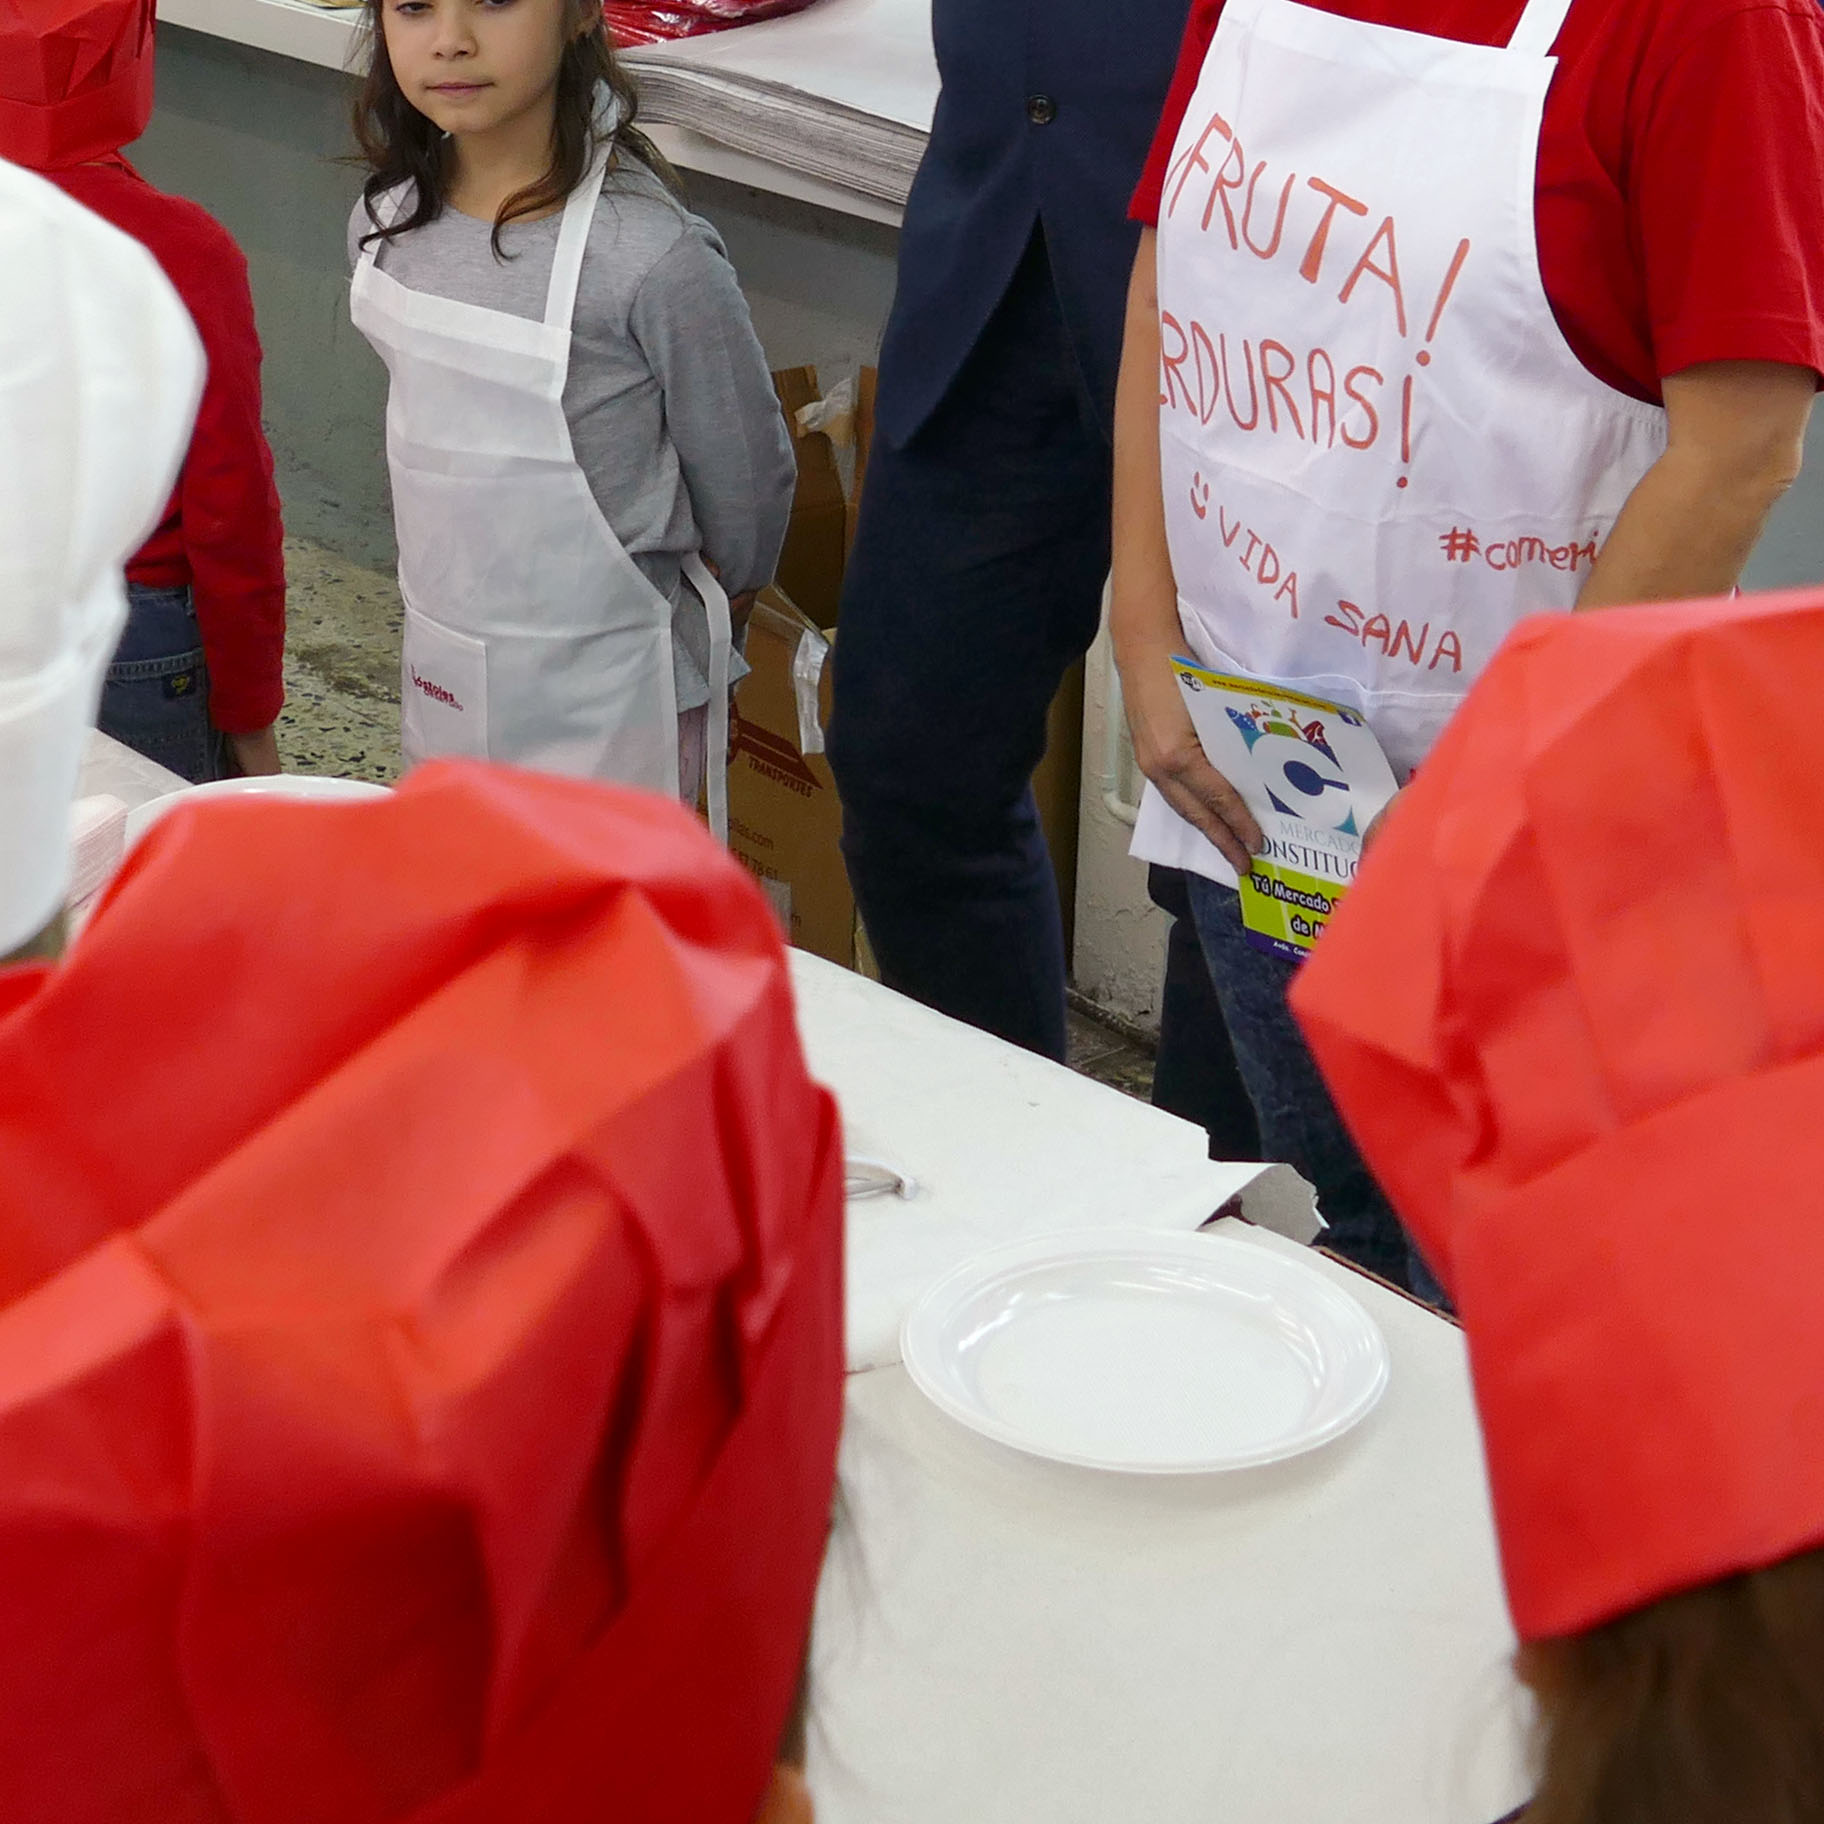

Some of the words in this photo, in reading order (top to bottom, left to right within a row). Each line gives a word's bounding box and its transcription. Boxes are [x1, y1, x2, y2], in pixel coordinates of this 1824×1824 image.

[1160, 309, 1413, 488] RDURAS!
[1220, 506, 1299, 619] VIDA
[1438, 525, 1601, 572] #comeri
[1324, 599, 1464, 673] SANA
[747, 755, 814, 799] TRANSPORTES
[1251, 874, 1271, 895] Tú
[1274, 880, 1330, 914] Mercado
[1292, 914, 1310, 935] de
